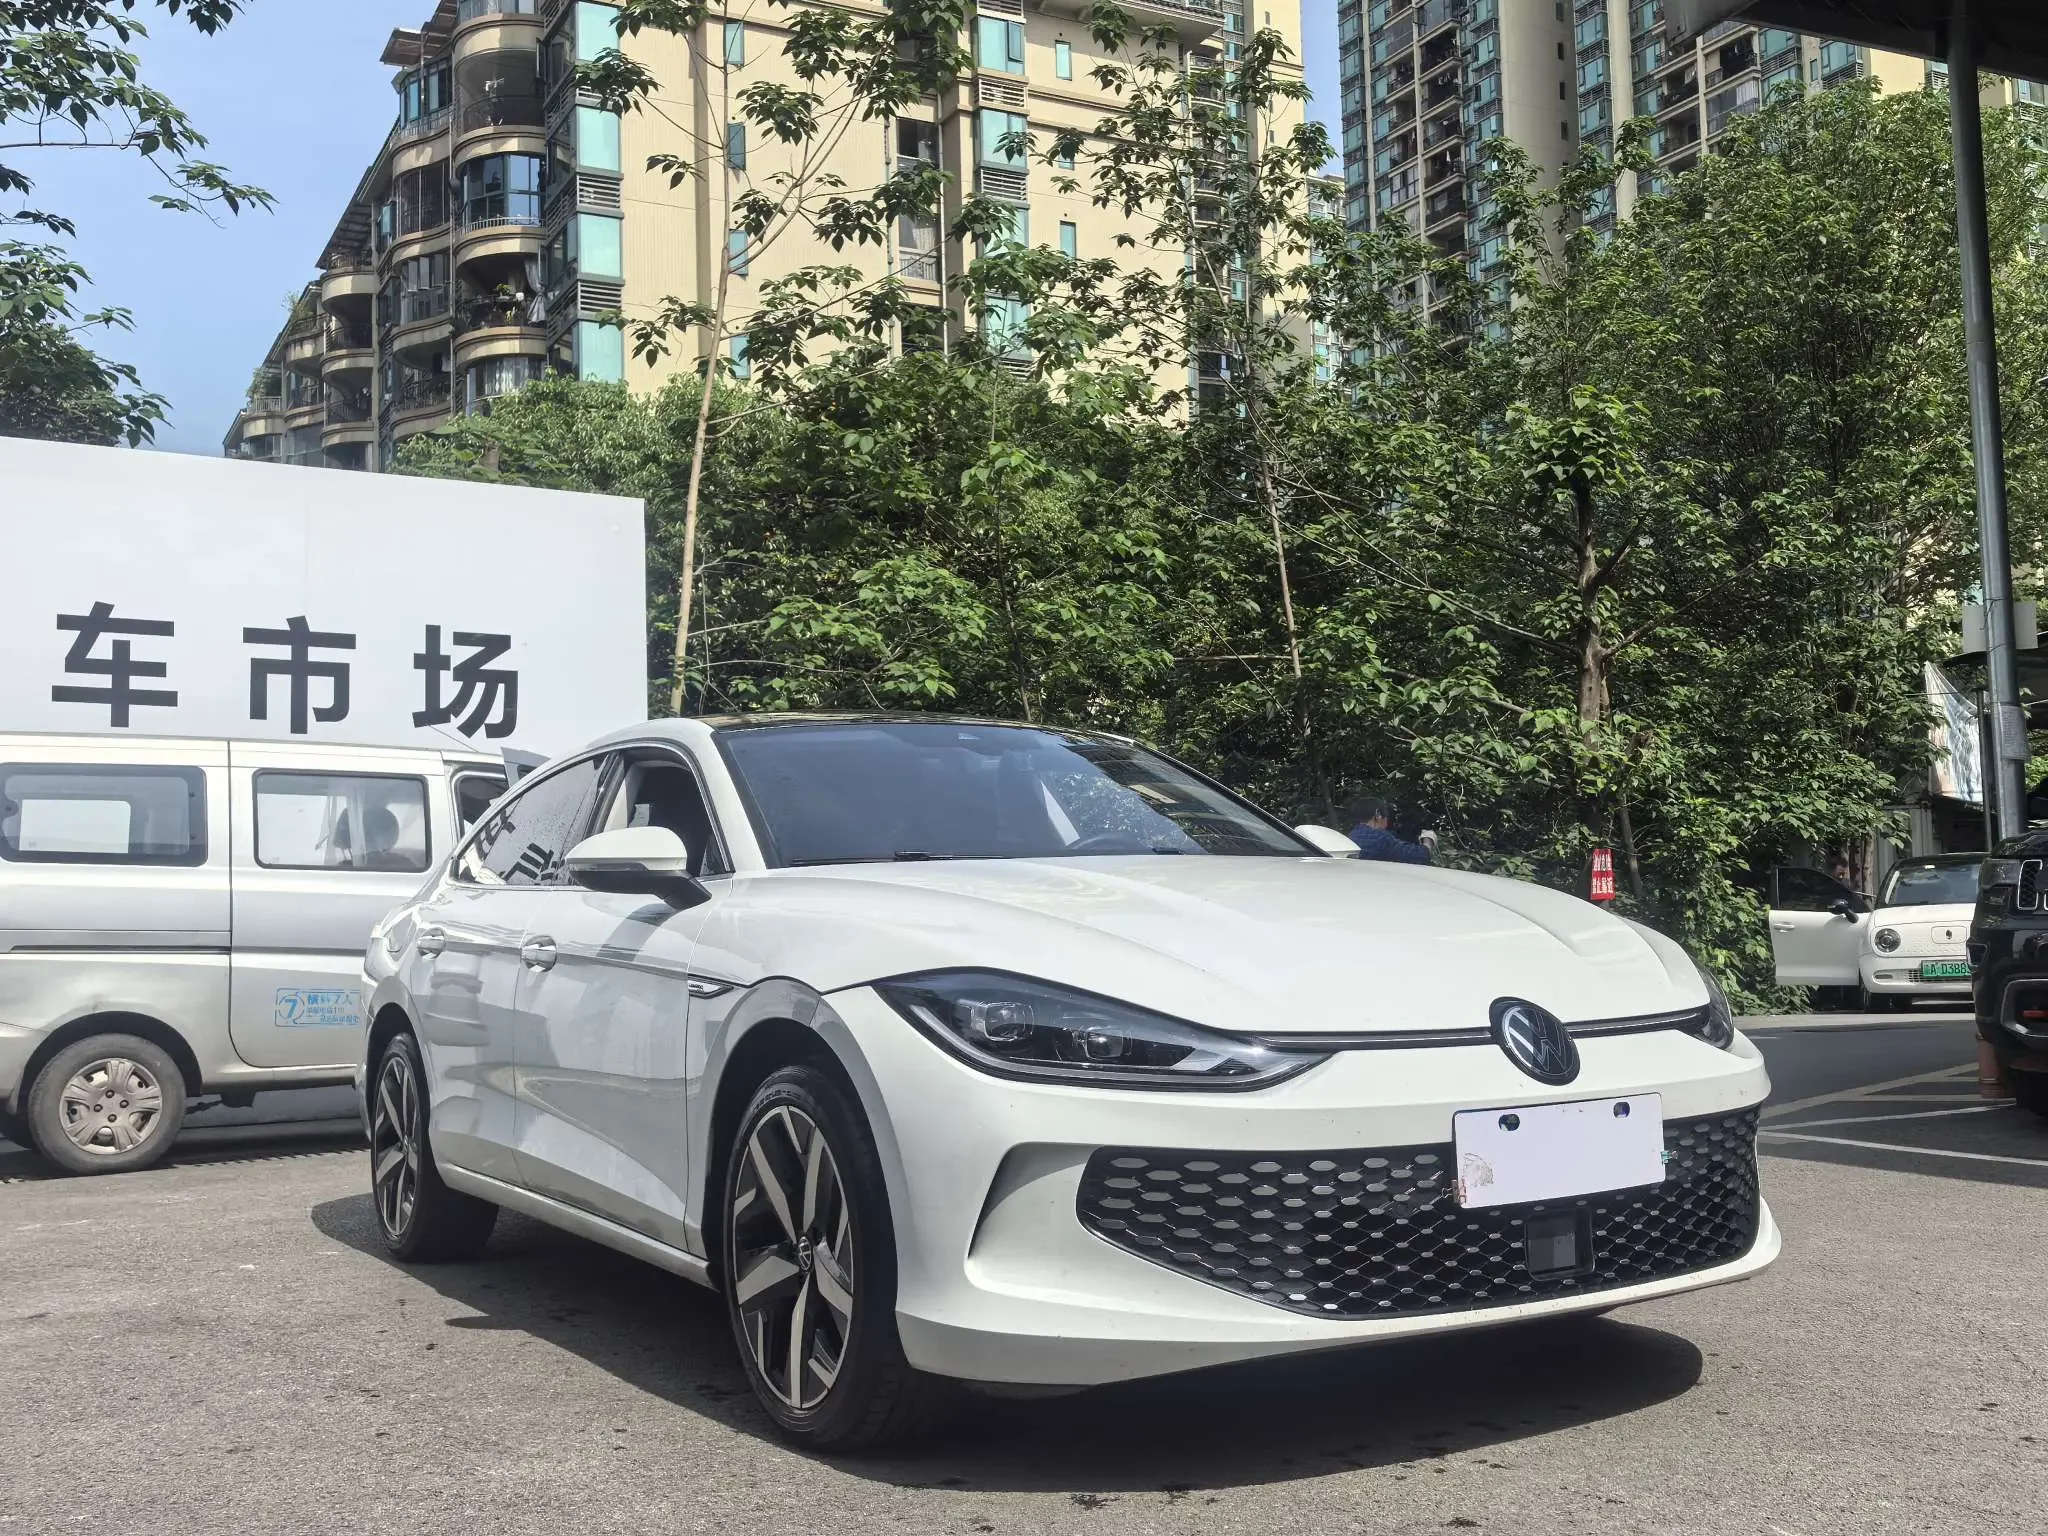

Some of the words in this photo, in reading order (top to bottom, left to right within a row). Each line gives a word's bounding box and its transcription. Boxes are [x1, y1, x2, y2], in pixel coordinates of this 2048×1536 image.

[51, 601, 519, 739] 车市场
[285, 999, 298, 1018] 7
